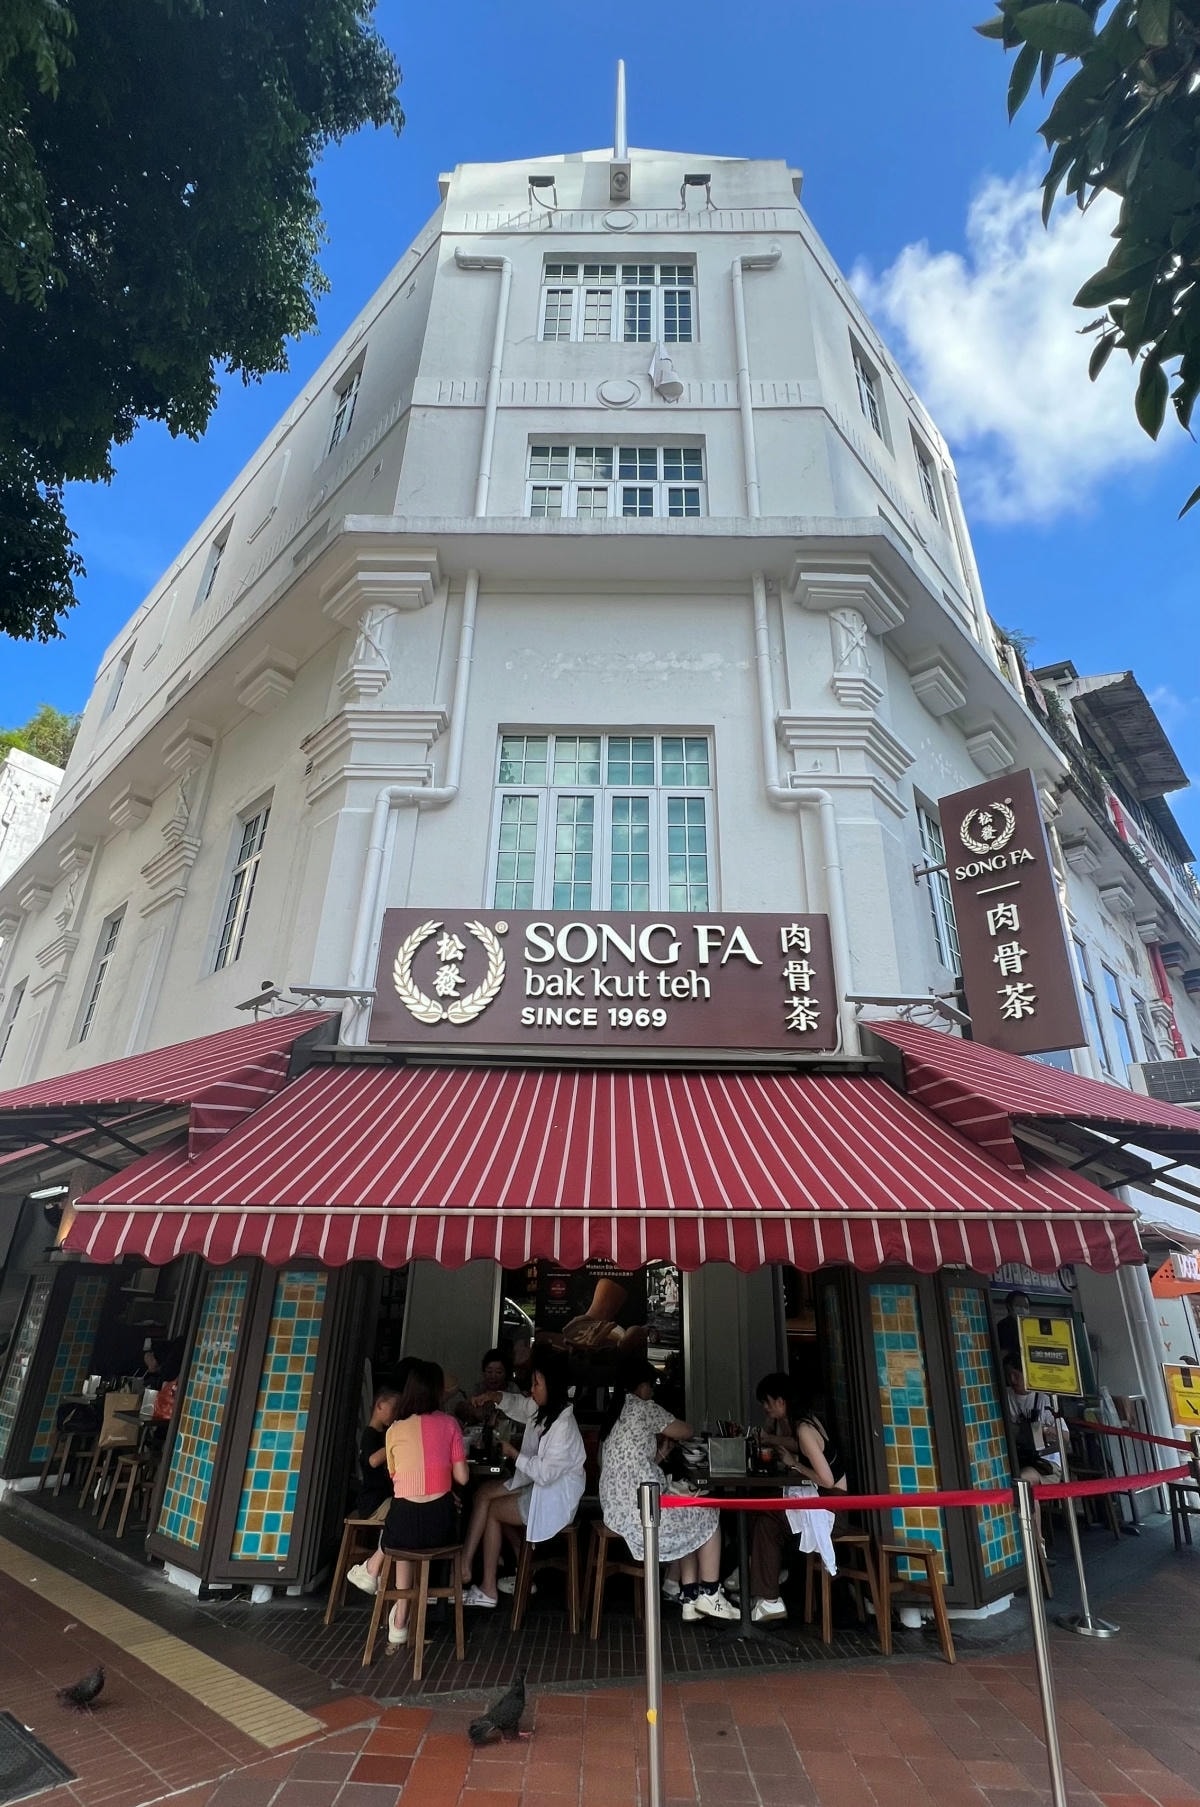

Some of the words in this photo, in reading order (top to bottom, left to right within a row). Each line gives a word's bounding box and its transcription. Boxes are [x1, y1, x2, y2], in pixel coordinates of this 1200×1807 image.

[977, 811, 998, 841] 松發
[954, 853, 1007, 881] SONG
[1009, 847, 1035, 866] FA
[523, 921, 682, 964] SONG
[692, 924, 764, 966] FA
[985, 902, 1037, 1020] 肉骨茶
[432, 930, 467, 998] 松發
[523, 967, 585, 998] bak
[591, 967, 650, 998] kut
[657, 969, 711, 999] teh
[780, 922, 820, 1033] 肉骨茶
[520, 1006, 598, 1026] SINCE
[606, 1007, 667, 1027] 1969
